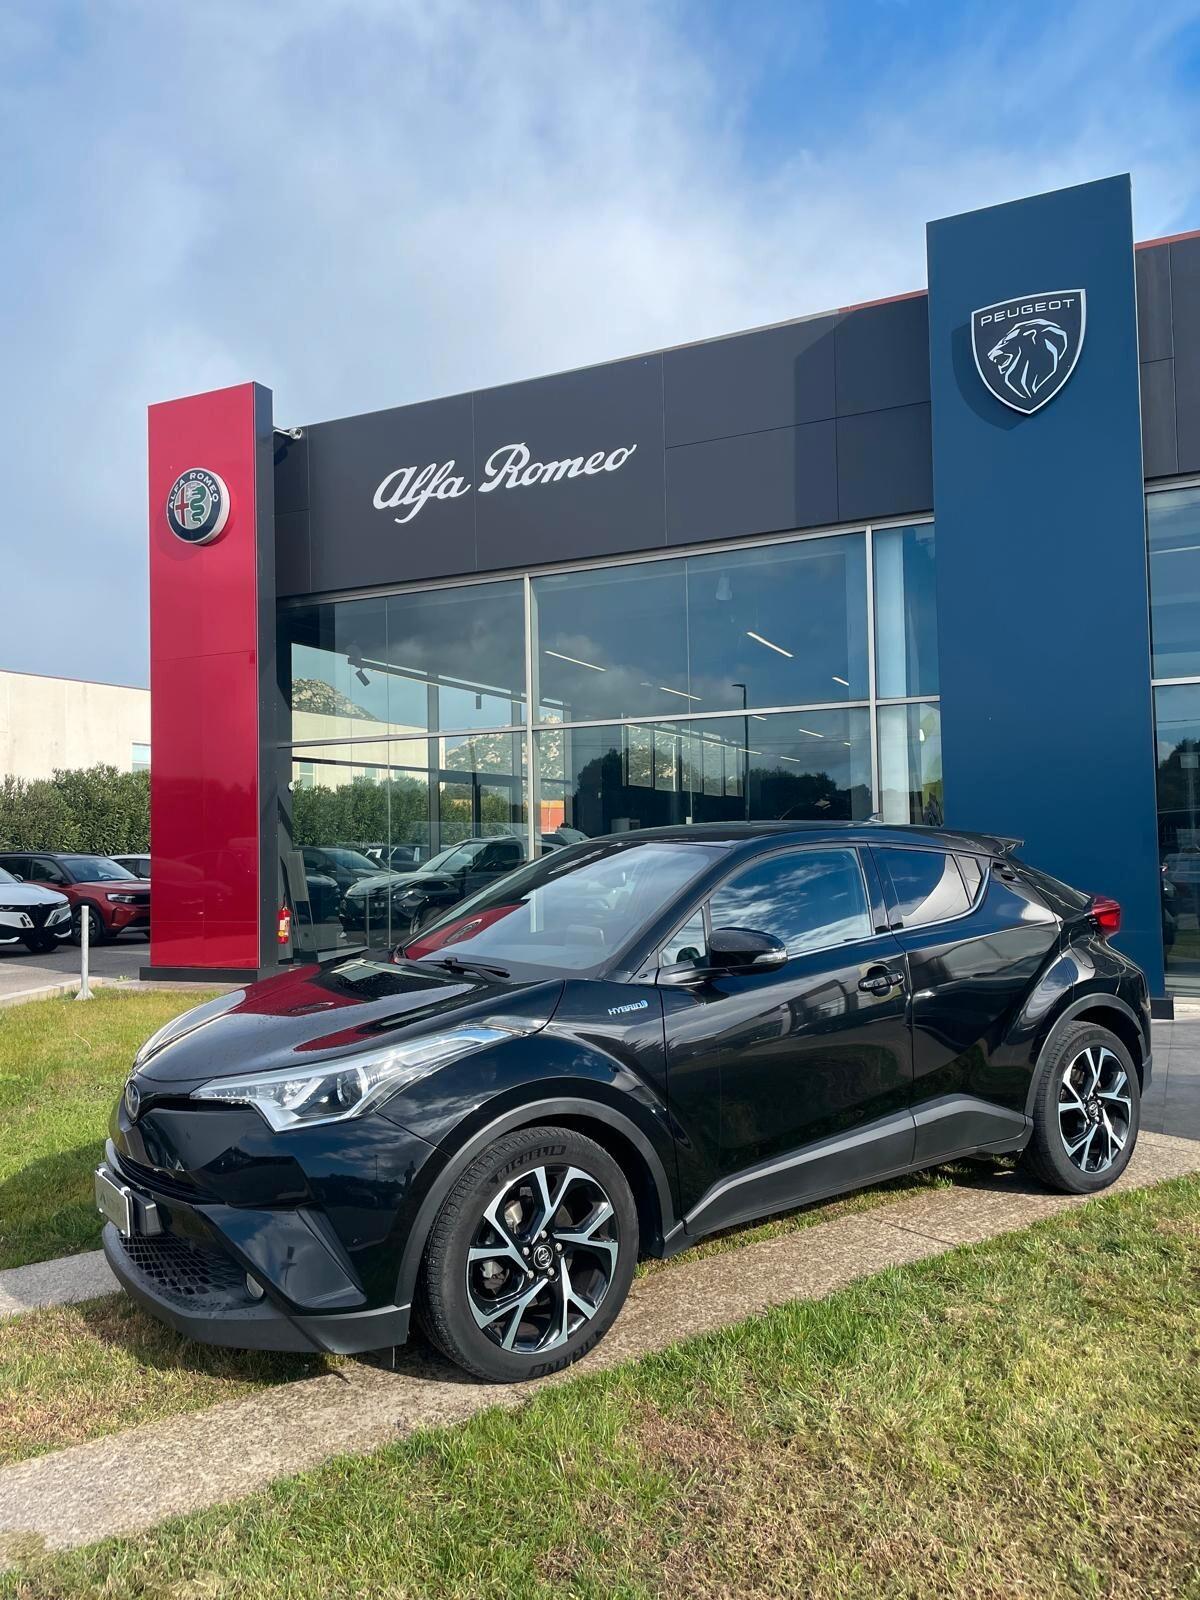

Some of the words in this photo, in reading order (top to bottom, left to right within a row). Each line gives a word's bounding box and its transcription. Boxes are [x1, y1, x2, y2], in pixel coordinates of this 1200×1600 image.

[980, 299, 1075, 327] PEUGEOT
[168, 478, 186, 510] ALFA
[189, 472, 219, 503] ROMEO
[373, 459, 472, 524] Alfa
[478, 442, 638, 493] Romeo
[607, 1002, 642, 1016] HYBRID
